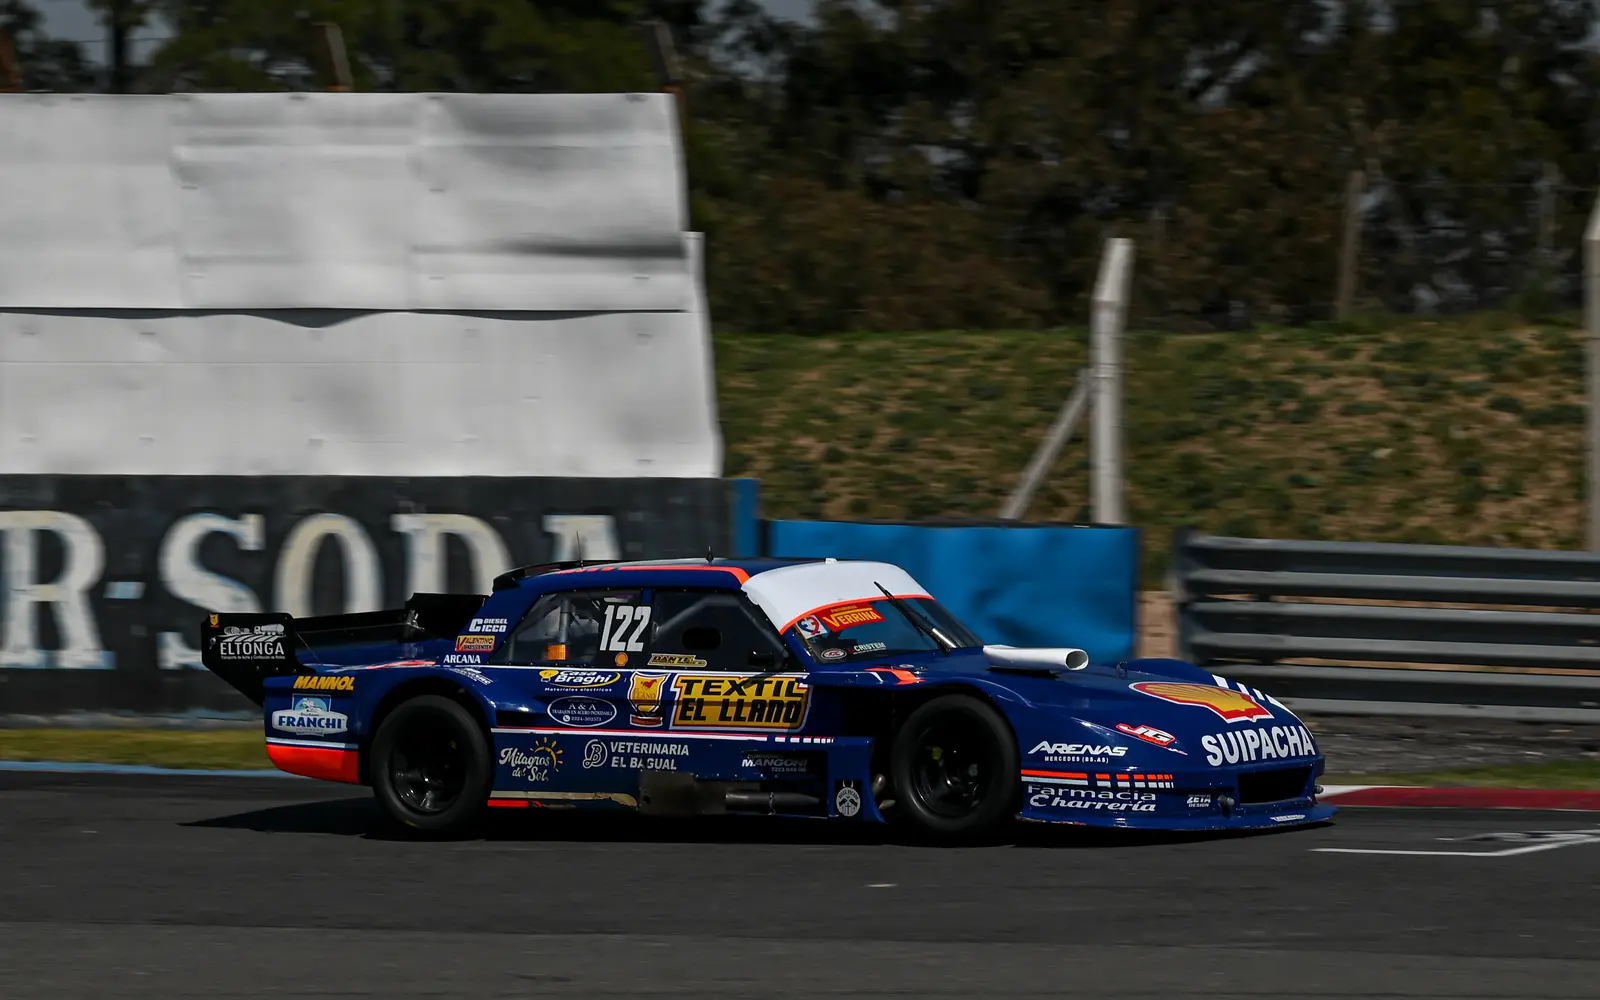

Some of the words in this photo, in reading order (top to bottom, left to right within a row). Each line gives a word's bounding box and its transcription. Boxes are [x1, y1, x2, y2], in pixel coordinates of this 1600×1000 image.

[469, 619, 507, 632] CICCO
[822, 609, 882, 628] VERRINA
[600, 605, 652, 652] 122
[457, 637, 494, 651] VALENTINO
[853, 642, 886, 652] CRISTEM
[443, 655, 481, 664] ARCANA
[293, 675, 355, 691] MANNOL
[554, 674, 612, 685] Braghi
[680, 679, 805, 698] TEXTIL
[678, 697, 706, 722] EL
[718, 698, 801, 724] LLANO
[278, 715, 342, 729] FRANCHI
[610, 741, 690, 756] VETERINARIA
[1028, 740, 1129, 757] ARENAS
[1201, 725, 1316, 767] SUIPACHA
[499, 747, 550, 769] Milagros
[611, 756, 627, 768] EL
[629, 757, 678, 770] BAGUAL
[1028, 783, 1156, 801] Farmacia
[1186, 794, 1211, 804] ZETA
